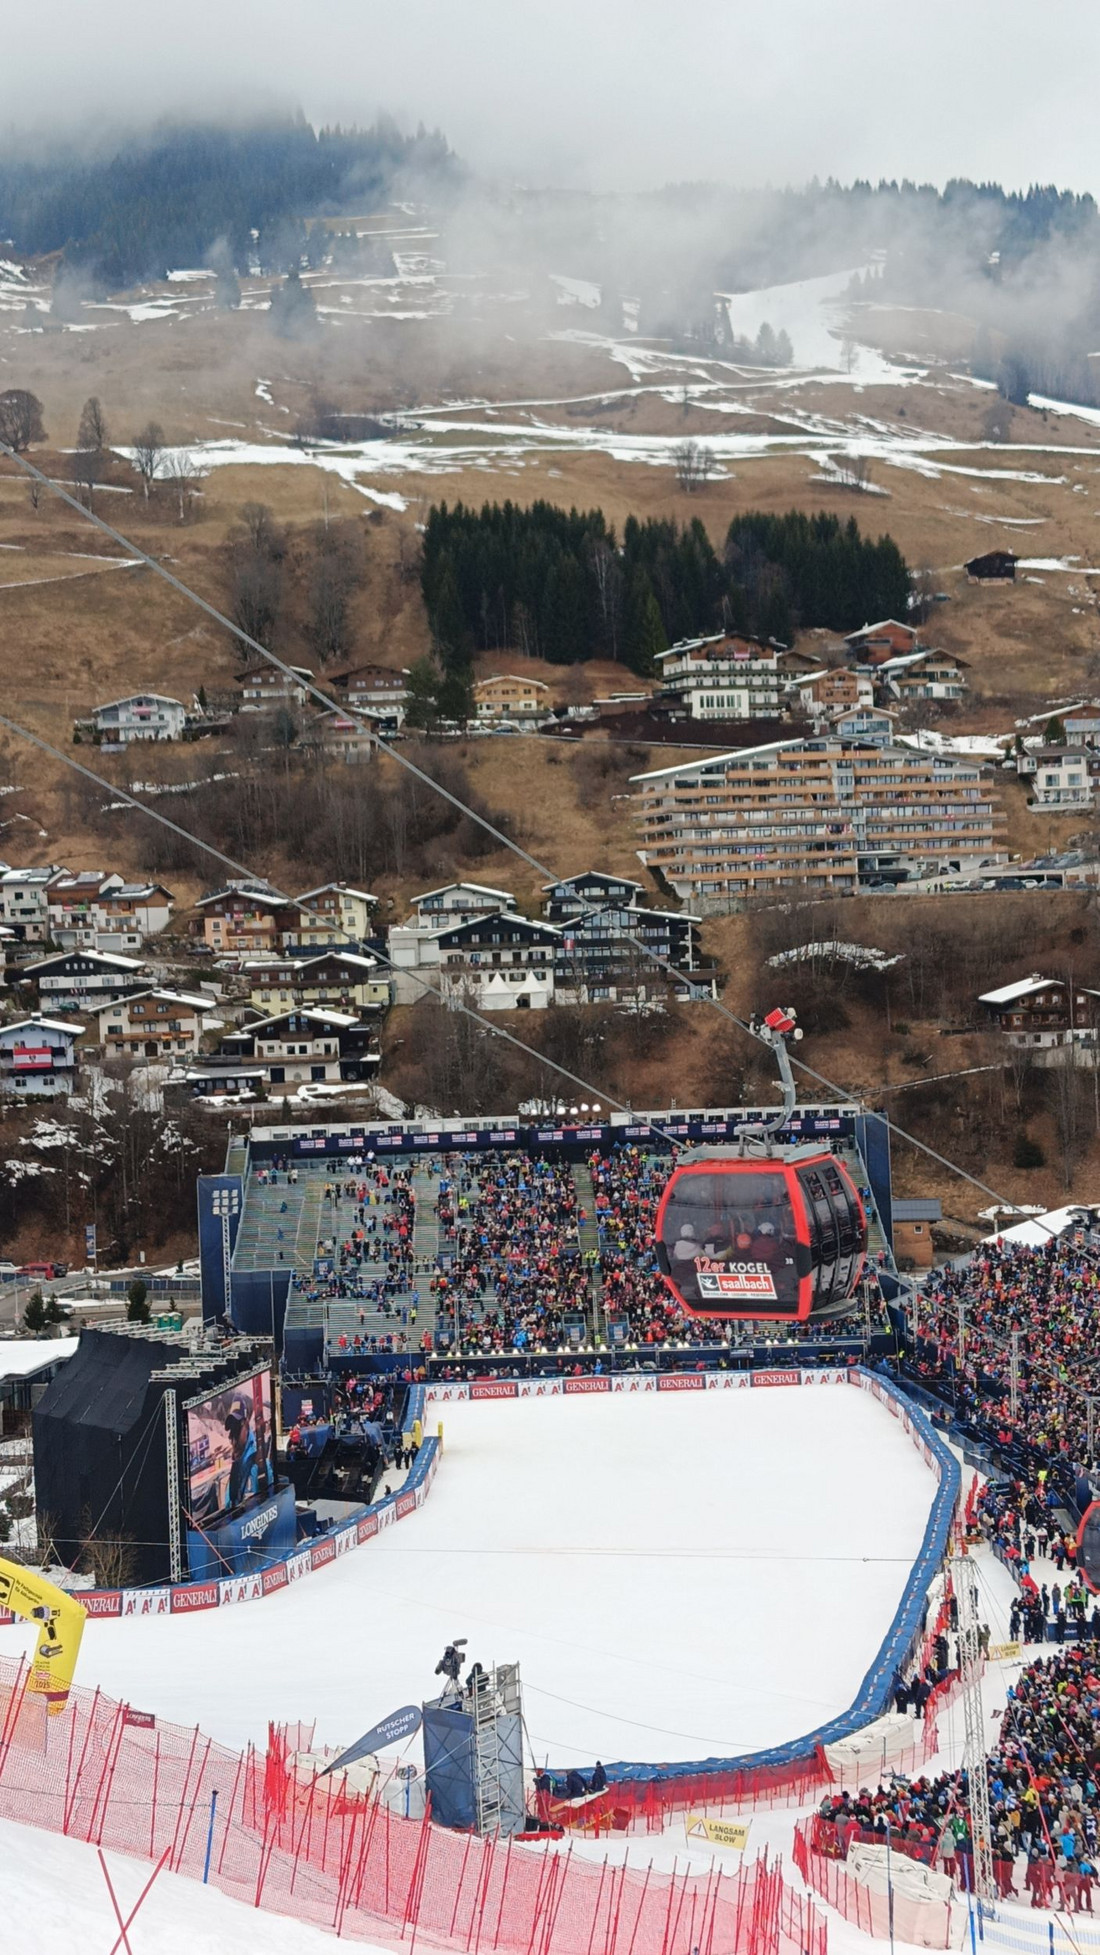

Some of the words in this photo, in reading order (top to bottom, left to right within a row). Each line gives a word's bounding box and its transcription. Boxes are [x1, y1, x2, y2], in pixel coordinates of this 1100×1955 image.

[694, 1256, 725, 1273] 12er
[730, 1262, 771, 1273] KOGEL
[722, 1274, 770, 1289] saalbach
[660, 1378, 703, 1389] GENERALI
[754, 1373, 798, 1384] GENERALI
[472, 1386, 515, 1397] GENERALI
[566, 1381, 609, 1391] GENERALI
[241, 1505, 277, 1540] LONGINES
[174, 1589, 217, 1607] GENERALI
[377, 1713, 415, 1734] RUTSCHER
[386, 1724, 408, 1740] STOPP
[709, 1824, 745, 1836] LANGSAM
[715, 1834, 736, 1843] SLOW
